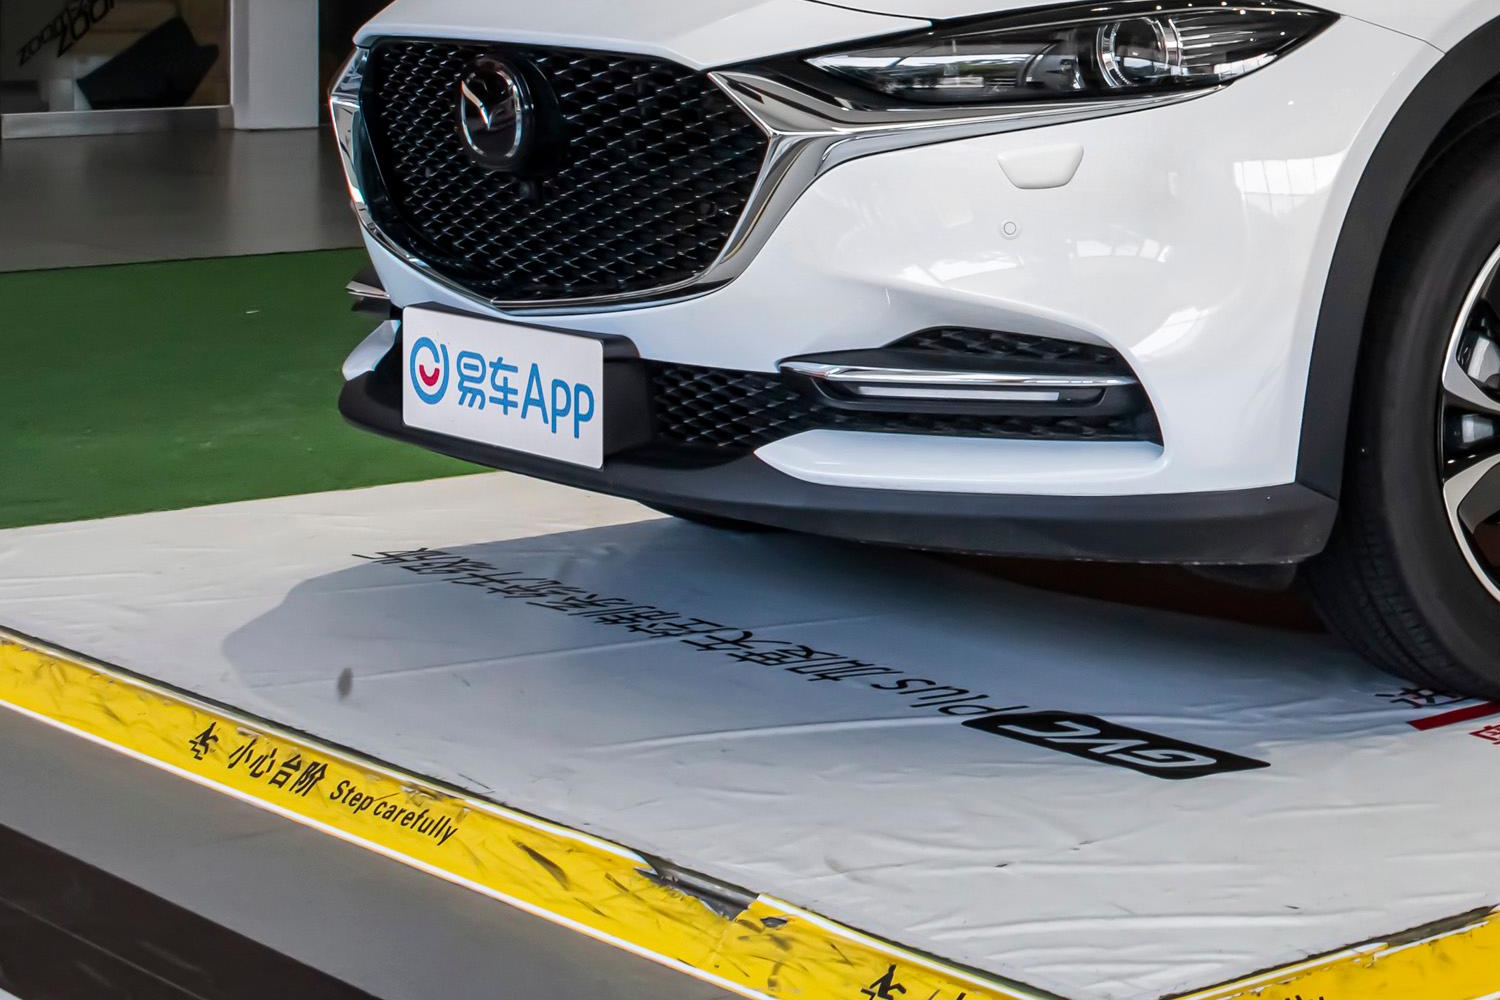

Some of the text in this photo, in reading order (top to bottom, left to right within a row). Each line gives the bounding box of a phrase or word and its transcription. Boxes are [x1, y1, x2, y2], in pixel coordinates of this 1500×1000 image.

[456, 350, 595, 439] 易车App
[228, 738, 458, 846] 小心台阶 Step carefully
